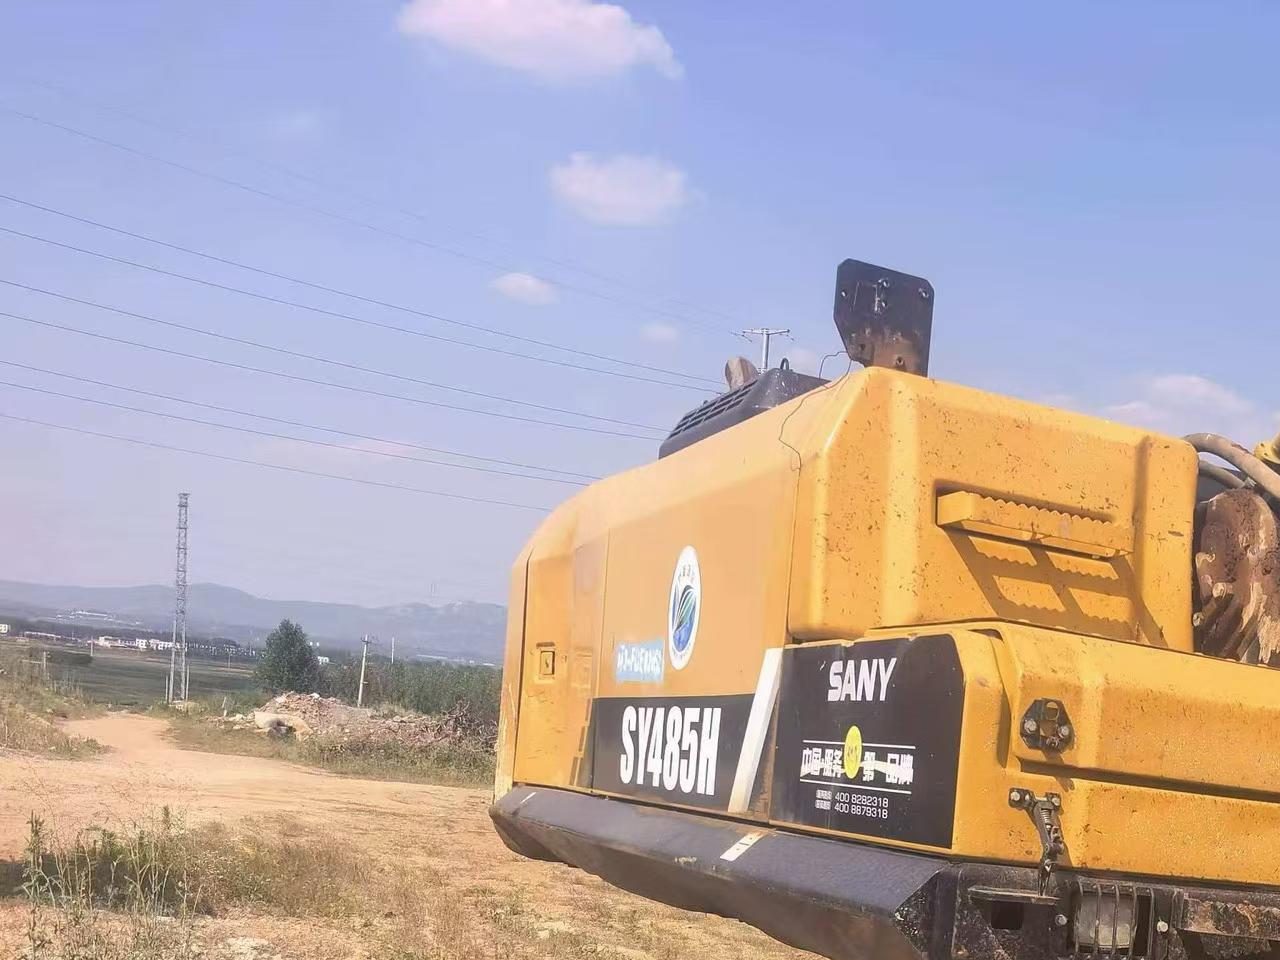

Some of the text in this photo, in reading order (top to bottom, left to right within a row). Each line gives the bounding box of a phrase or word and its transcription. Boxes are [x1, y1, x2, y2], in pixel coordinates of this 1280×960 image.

[827, 657, 898, 702] SANY
[619, 705, 722, 796] SY485H
[834, 791, 850, 803] 400
[851, 793, 889, 808] 8282318
[834, 802, 850, 814] 400
[850, 804, 888, 819] 8879318
